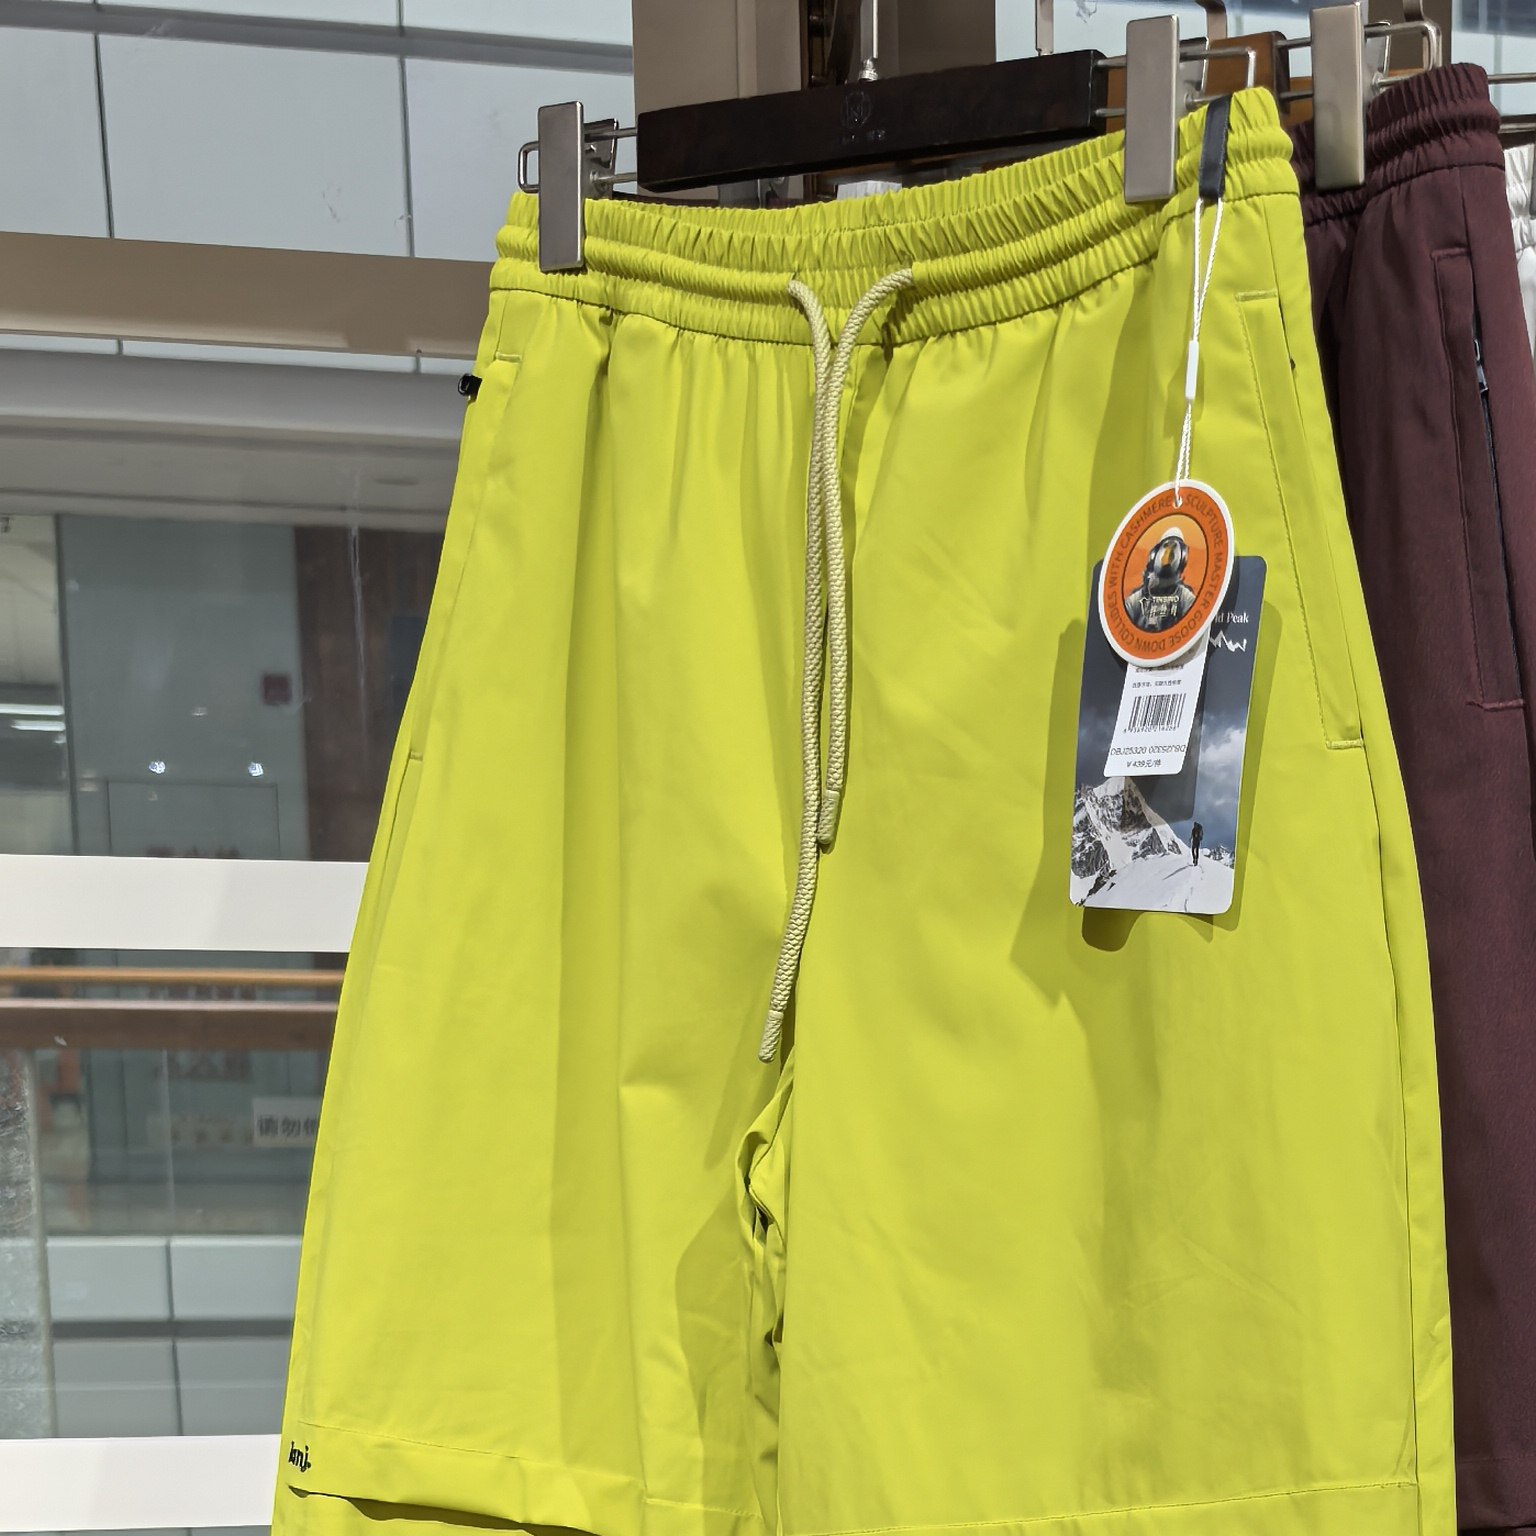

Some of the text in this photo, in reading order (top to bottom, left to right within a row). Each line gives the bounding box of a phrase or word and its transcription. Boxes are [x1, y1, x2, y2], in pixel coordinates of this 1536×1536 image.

[1122, 496, 1172, 550] CASHMERE
[1185, 494, 1223, 547] SCULPTURE
[1108, 551, 1123, 589] WITH
[1201, 552, 1224, 610] MASTER
[1107, 592, 1135, 646] COLLIDES
[1169, 611, 1203, 648] GOOSE
[1226, 611, 1249, 624] Peak
[1136, 638, 1166, 653] DOWN
